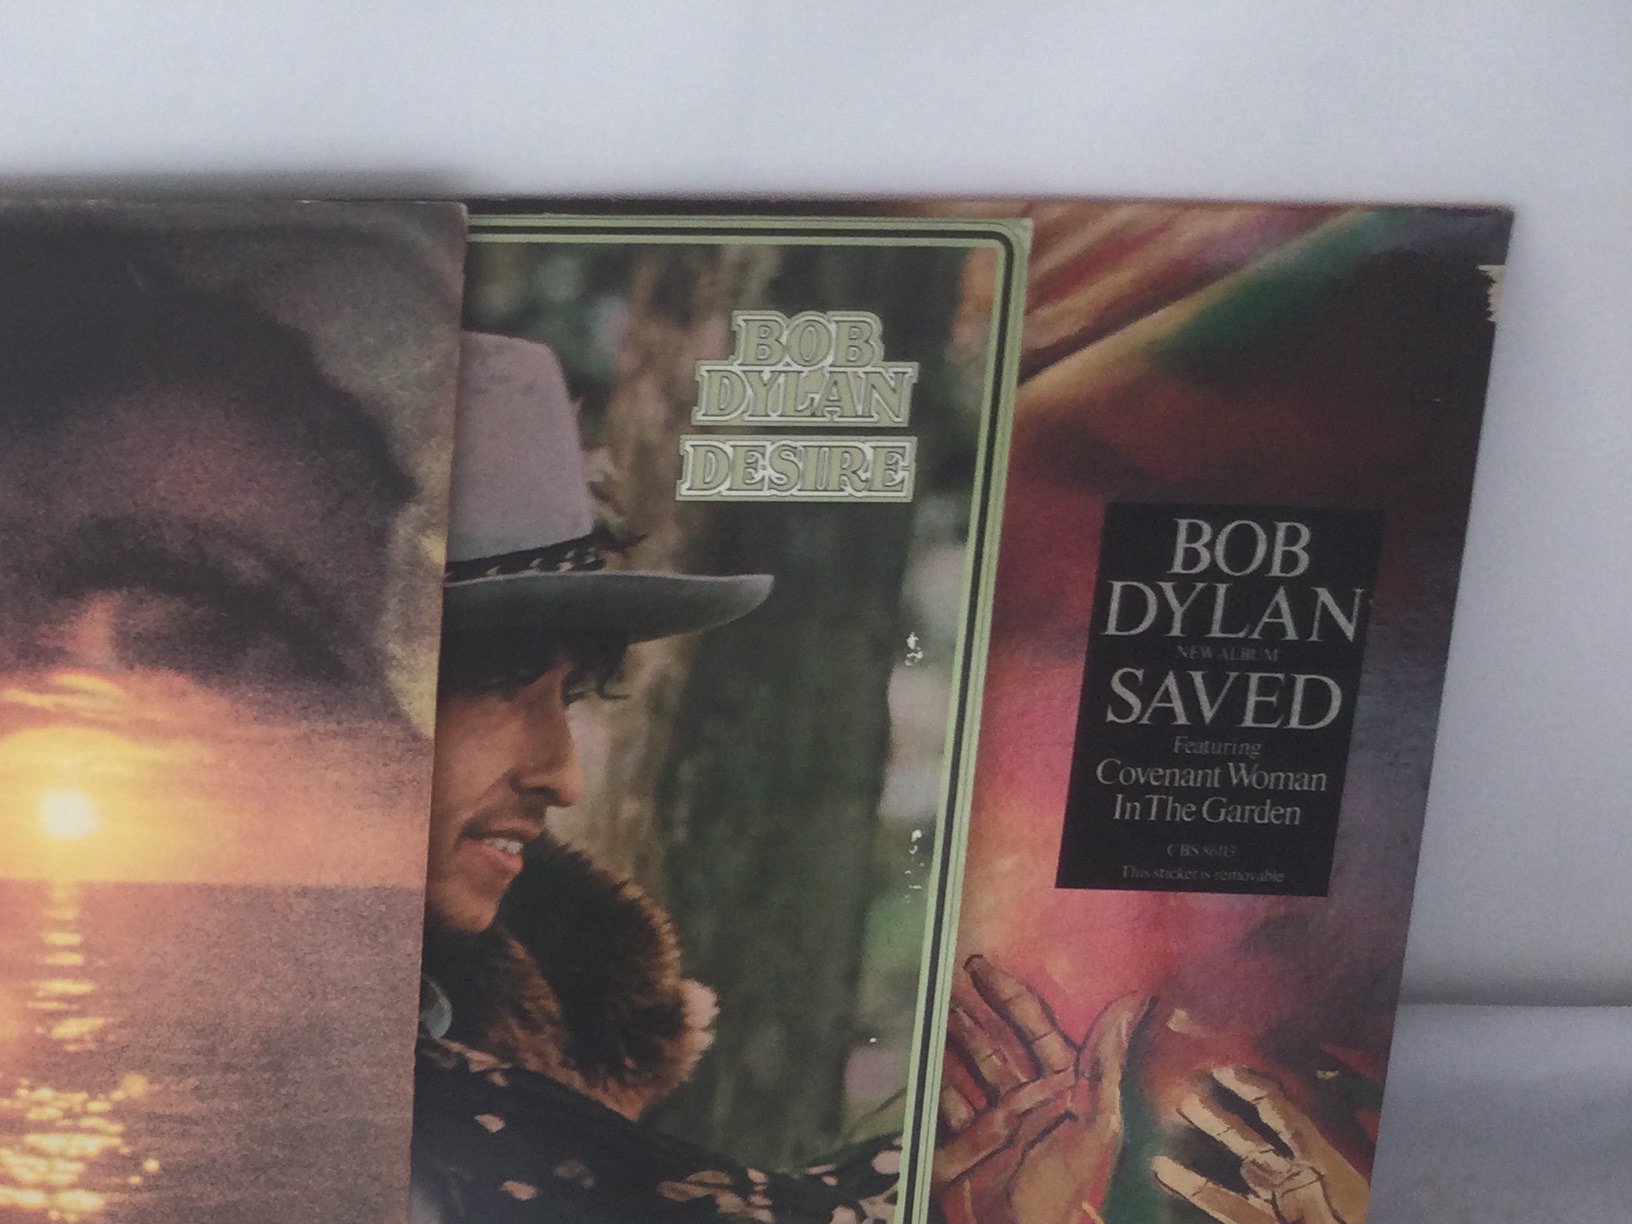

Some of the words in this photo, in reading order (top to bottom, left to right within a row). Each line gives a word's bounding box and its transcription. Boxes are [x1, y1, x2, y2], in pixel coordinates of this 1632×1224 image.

[733, 312, 883, 367] BOB
[692, 362, 918, 426] DYLAN
[676, 436, 917, 501] DESIRE
[1167, 518, 1312, 577] BOB
[1101, 581, 1365, 643] DYLAN
[1106, 667, 1342, 730] SAVED
[1096, 758, 1221, 788] Covenant
[1228, 762, 1327, 791] Woman
[1173, 736, 1262, 759] Featuring
[1113, 794, 1140, 820] In
[1145, 794, 1197, 822] The
[1202, 796, 1301, 825] Garden
